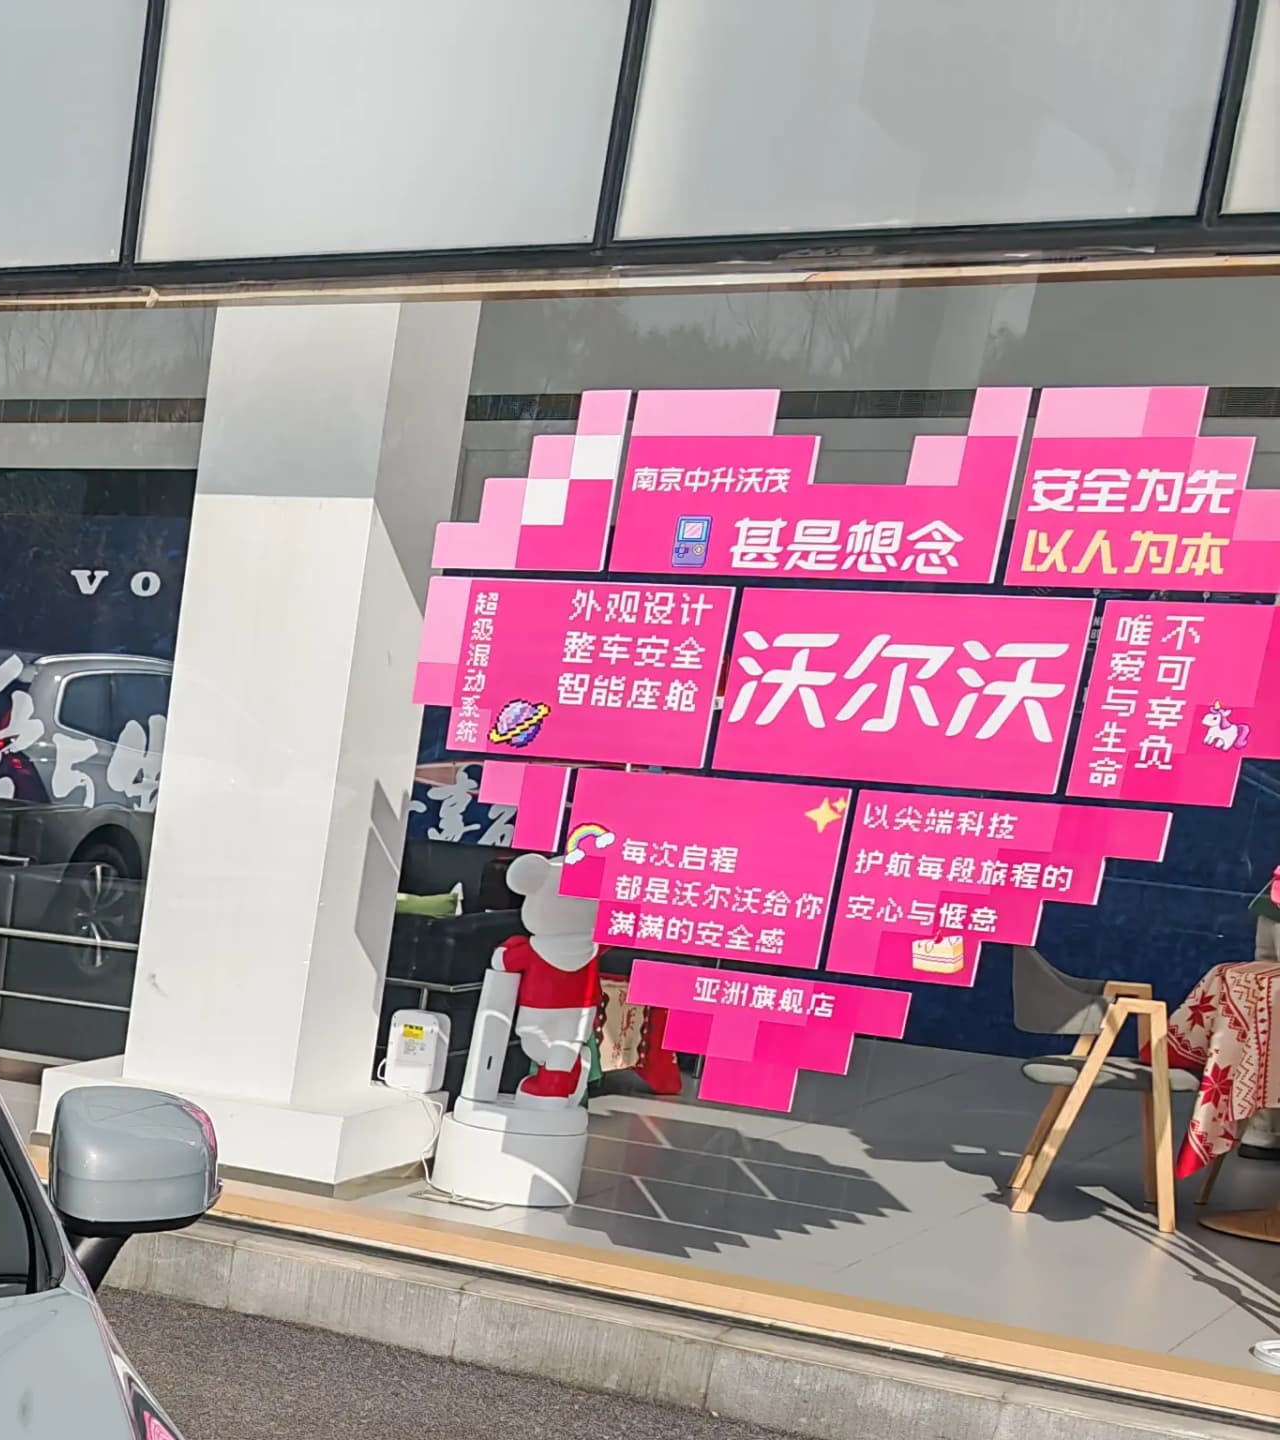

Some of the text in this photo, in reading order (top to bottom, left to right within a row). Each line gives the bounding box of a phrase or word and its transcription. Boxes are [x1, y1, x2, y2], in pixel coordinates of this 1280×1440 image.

[631, 467, 792, 494] 南京中升沃茂
[1027, 468, 1238, 515] 安全为先
[729, 517, 964, 575] 甚是想念
[1020, 528, 1232, 576] 以人为本
[568, 589, 714, 626] 外观设计
[454, 591, 500, 744] 超级混动系统
[561, 630, 706, 670] 整车安全
[556, 672, 700, 713] 智能座舱
[727, 631, 1071, 744] 沃尔沃
[1088, 614, 1154, 788] 唯爱与生命
[1134, 615, 1205, 771] 不可辜负
[863, 802, 1019, 841] 以尖端科技
[621, 838, 739, 874] 每次启程
[853, 848, 1074, 892] 护航每段旅程的
[614, 875, 824, 920] 都是沃尔沃给你
[845, 895, 1000, 933] 安心与惬意
[607, 910, 786, 955] 满满的安全感
[692, 976, 837, 1018] 亚洲旗舰店
